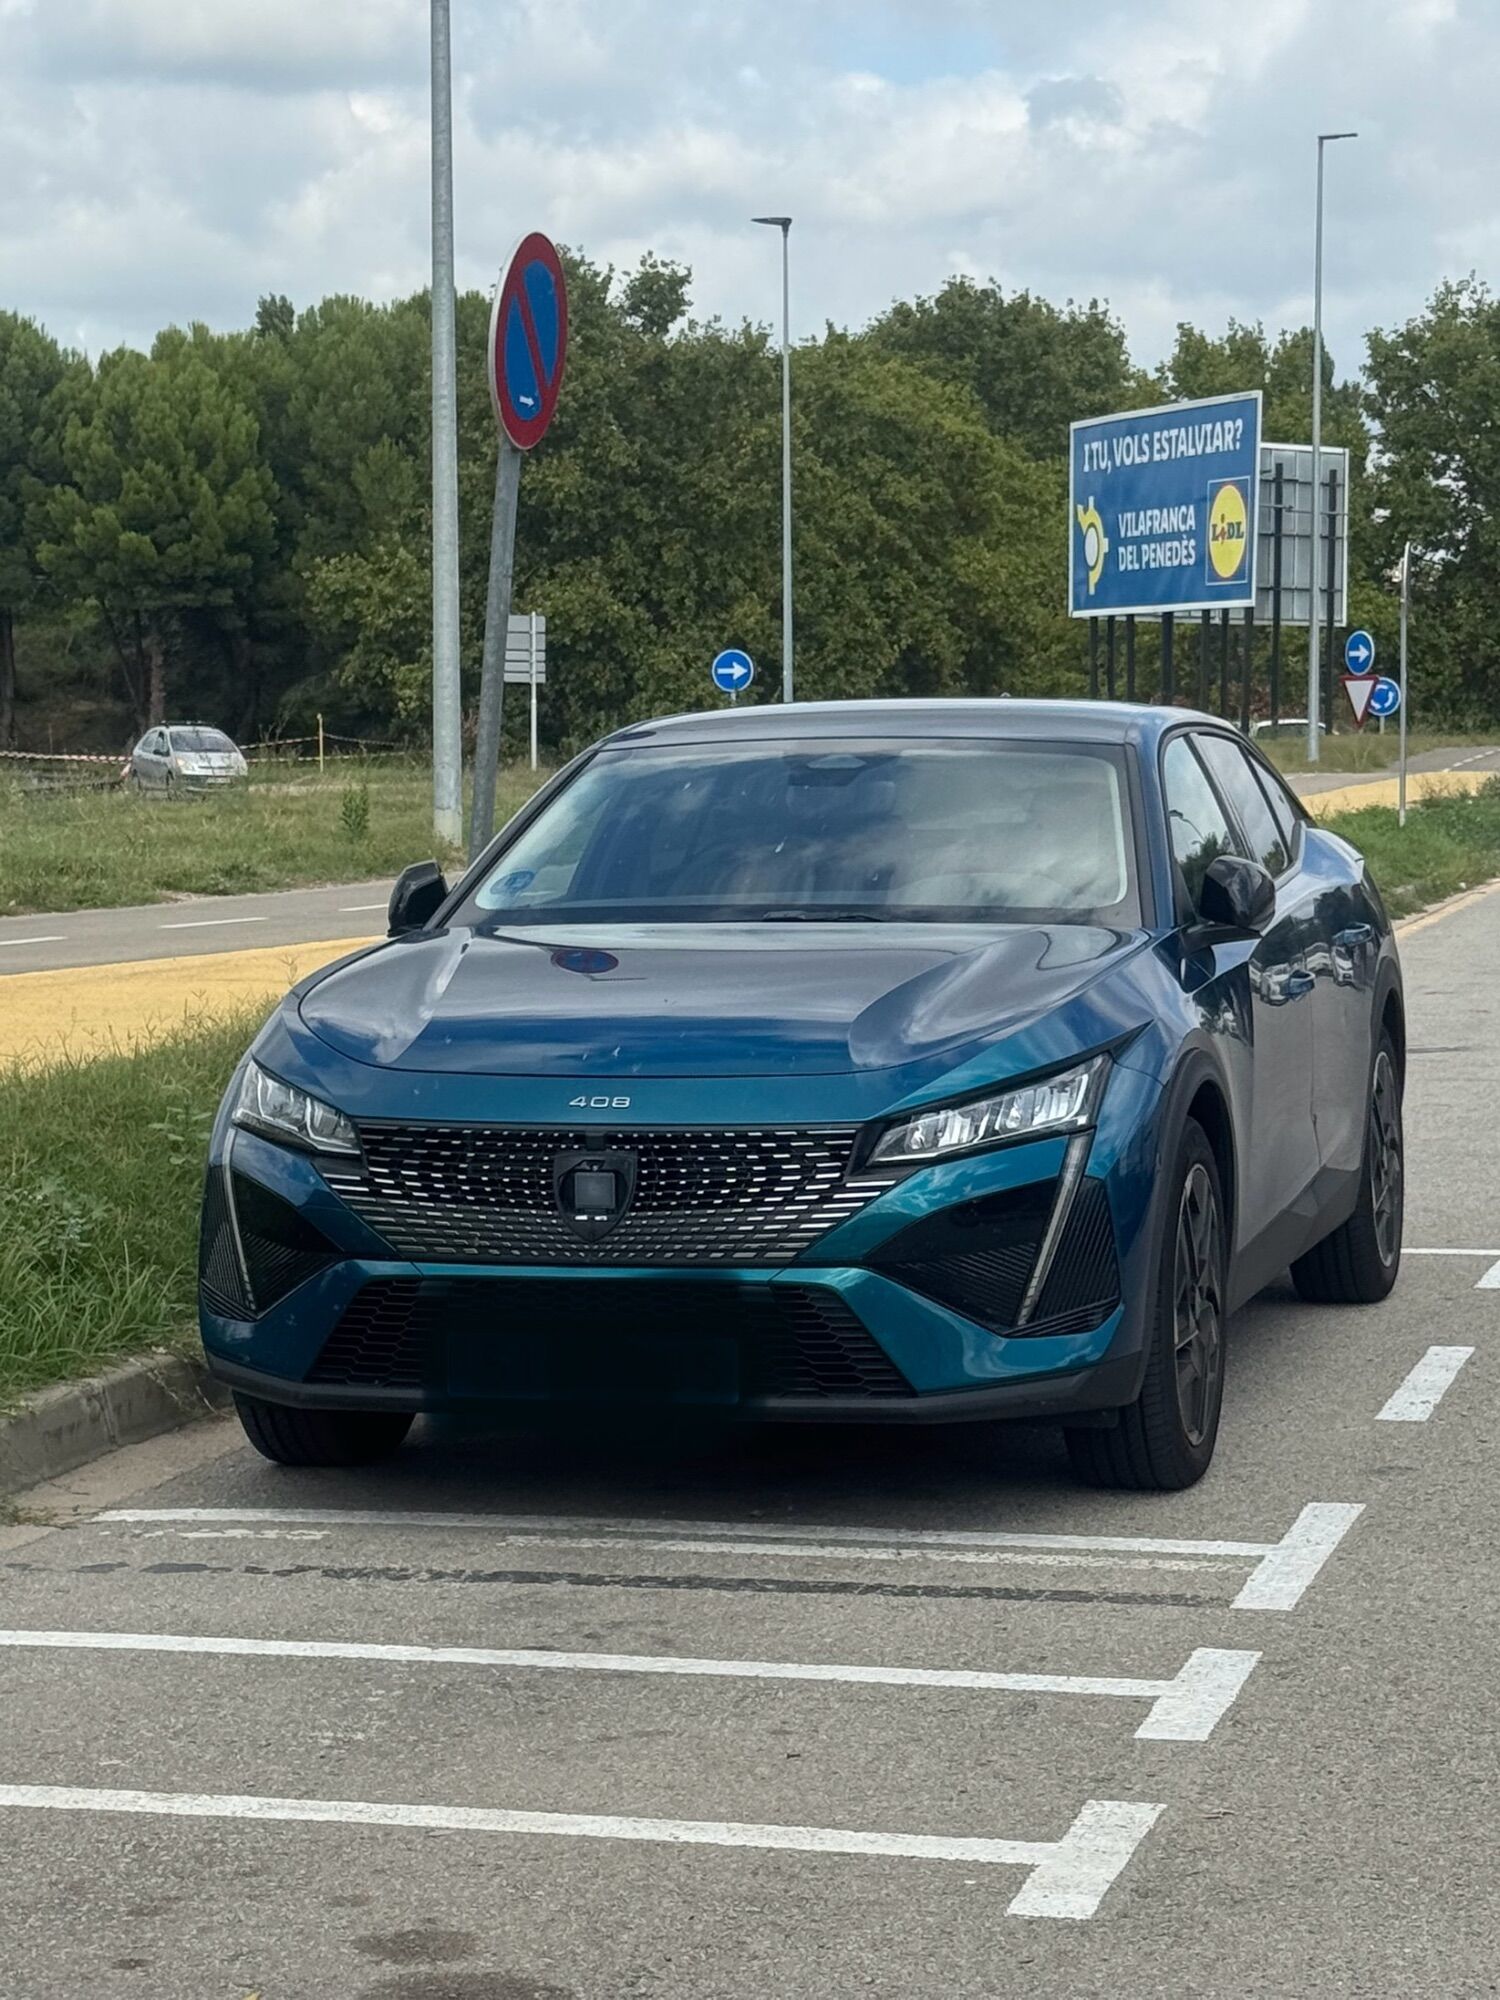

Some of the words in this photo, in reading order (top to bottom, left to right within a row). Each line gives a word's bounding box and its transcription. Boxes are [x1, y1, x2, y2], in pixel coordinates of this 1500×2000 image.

[1083, 444, 1089, 473] I
[1091, 439, 1112, 474] TU,
[1113, 433, 1150, 467] VOLS
[1153, 418, 1243, 461] ESTALVIAR?
[1118, 505, 1196, 539] VILAFRANCA
[1118, 544, 1140, 572] DEL
[1141, 533, 1196, 570] PENEDÈS
[568, 1096, 631, 1108] 408
